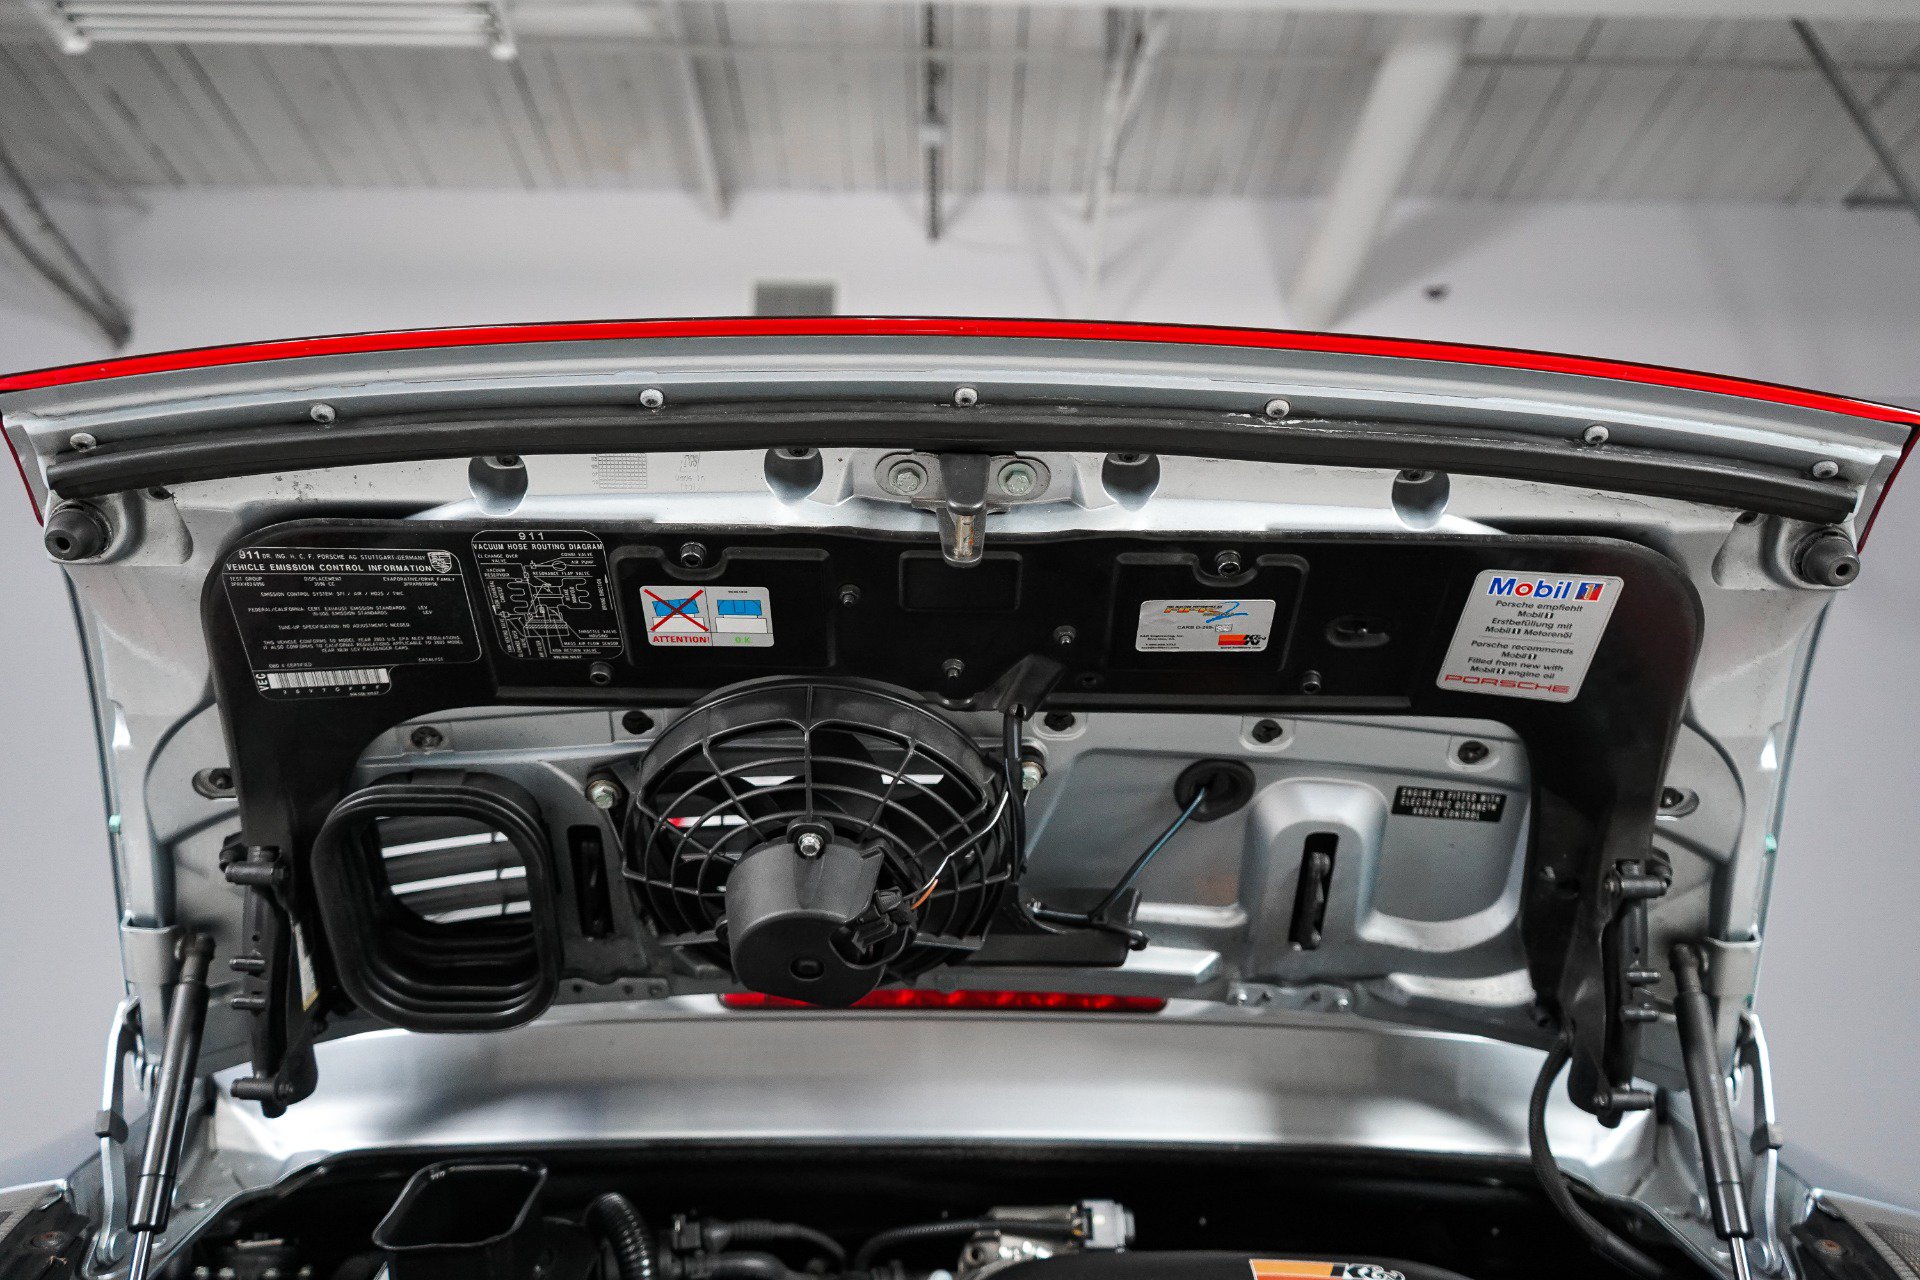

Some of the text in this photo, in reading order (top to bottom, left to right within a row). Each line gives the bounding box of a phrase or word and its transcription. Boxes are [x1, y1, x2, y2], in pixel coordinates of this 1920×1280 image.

[518, 532, 545, 540] 911
[238, 550, 260, 560] 911
[319, 564, 363, 572] CONTROL
[1488, 576, 1572, 599] Mobil
[1495, 600, 1583, 612] Porsche empfiehlt
[1492, 618, 1573, 630] Erstbefüllung mit
[1485, 626, 1511, 634] Mobil
[1524, 629, 1573, 639] Motorenöl
[1471, 640, 1573, 655] Porsche recommends
[1468, 657, 1493, 665] Filled
[1501, 651, 1527, 660] Mobil
[1470, 666, 1495, 674] Mobil
[1508, 670, 1540, 678] engine
[256, 673, 269, 691] VEC
[1445, 675, 1570, 693] PORSCHE
